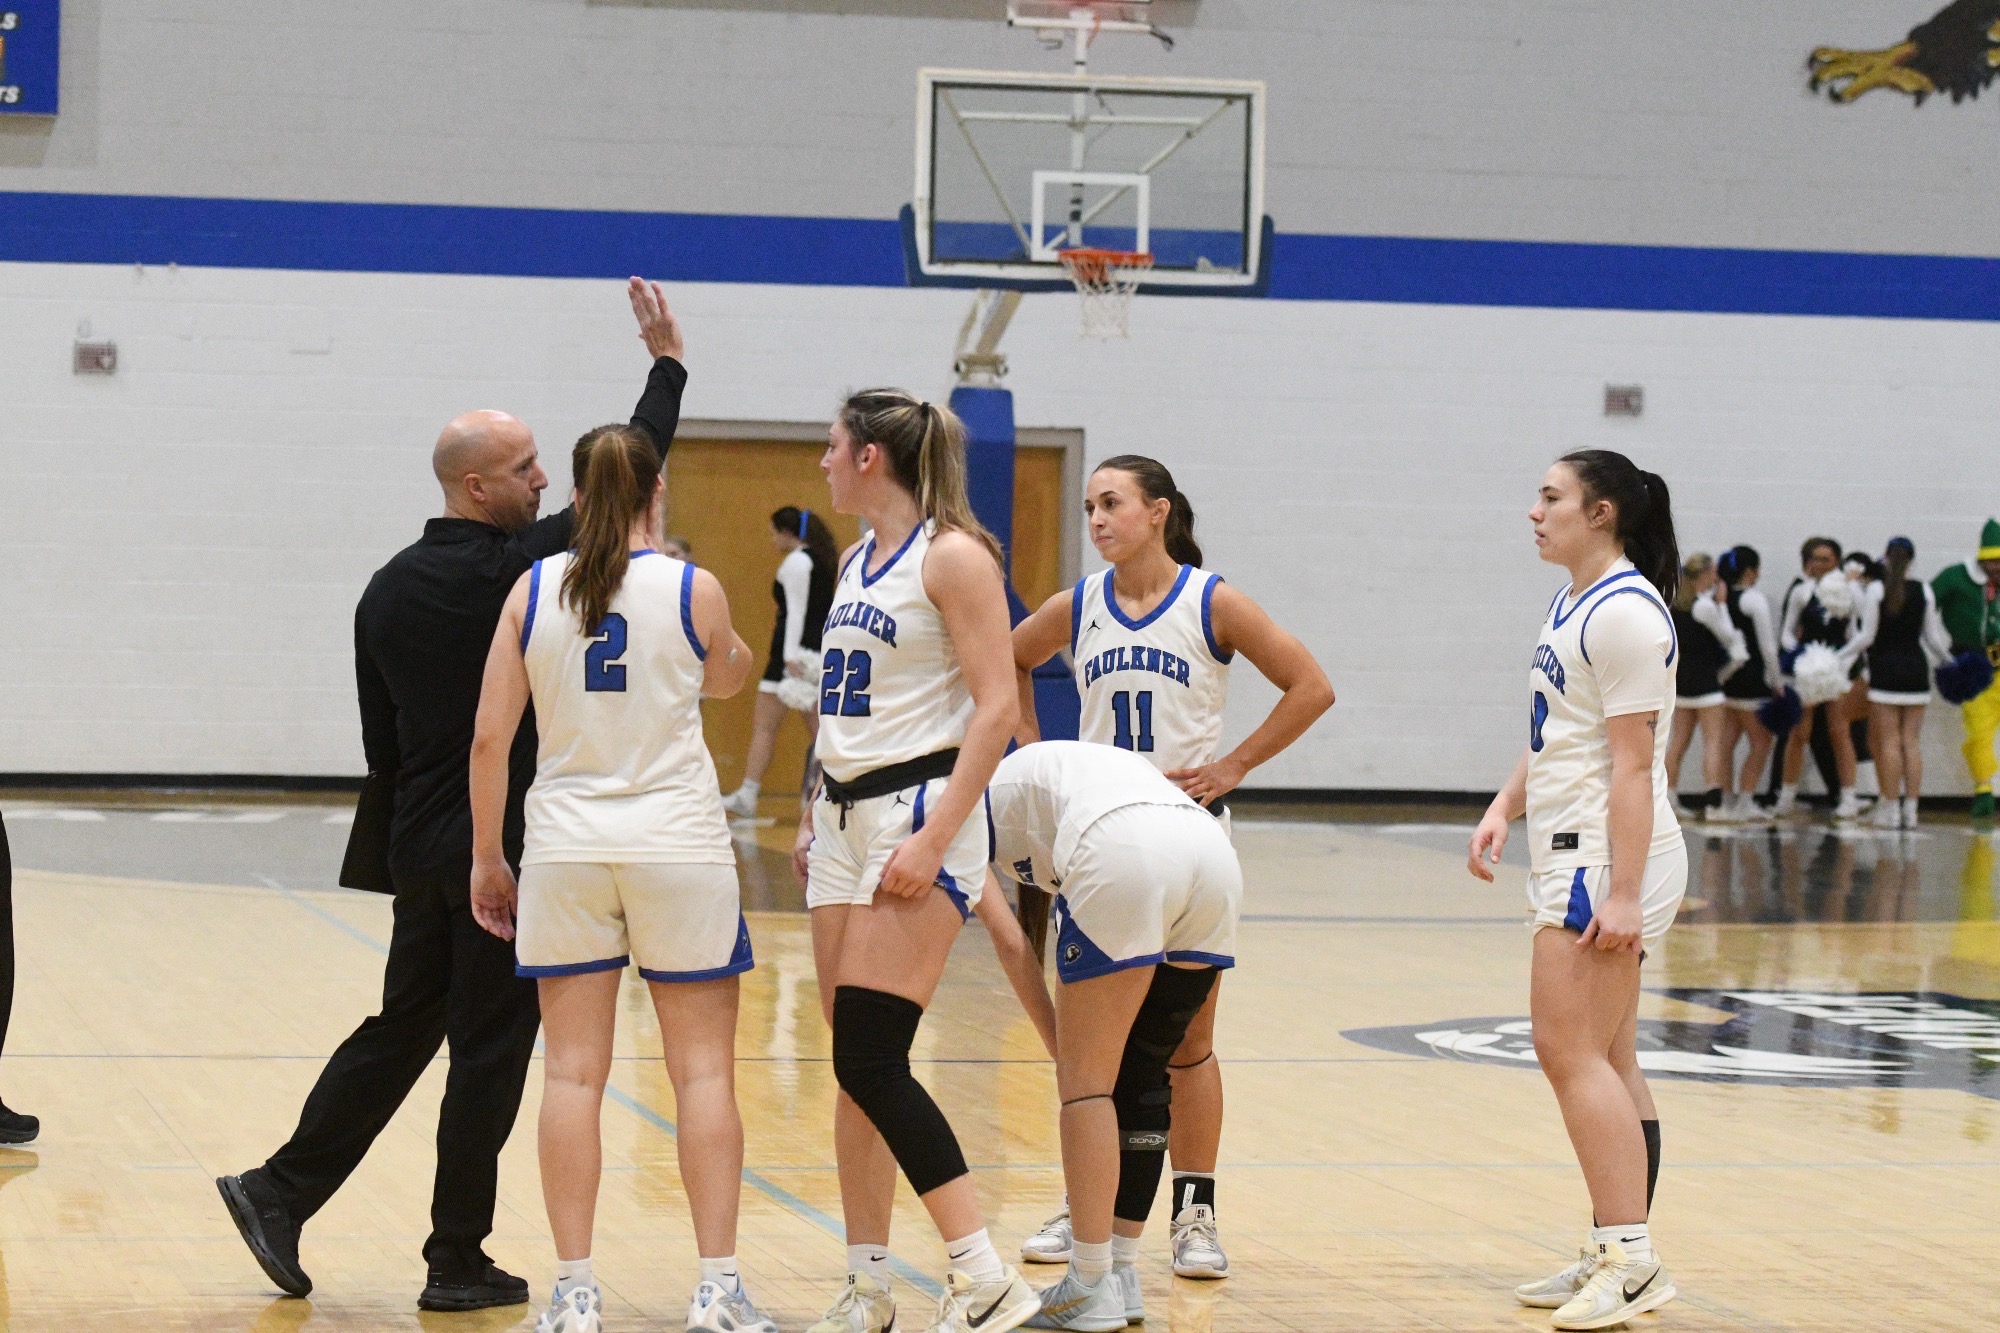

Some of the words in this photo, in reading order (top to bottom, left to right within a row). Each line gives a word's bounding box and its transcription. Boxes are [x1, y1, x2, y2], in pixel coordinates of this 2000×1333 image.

[584, 612, 628, 692] 2
[820, 648, 872, 717] 22
[1084, 645, 1190, 689] FAULKNER
[1111, 690, 1154, 753] 11
